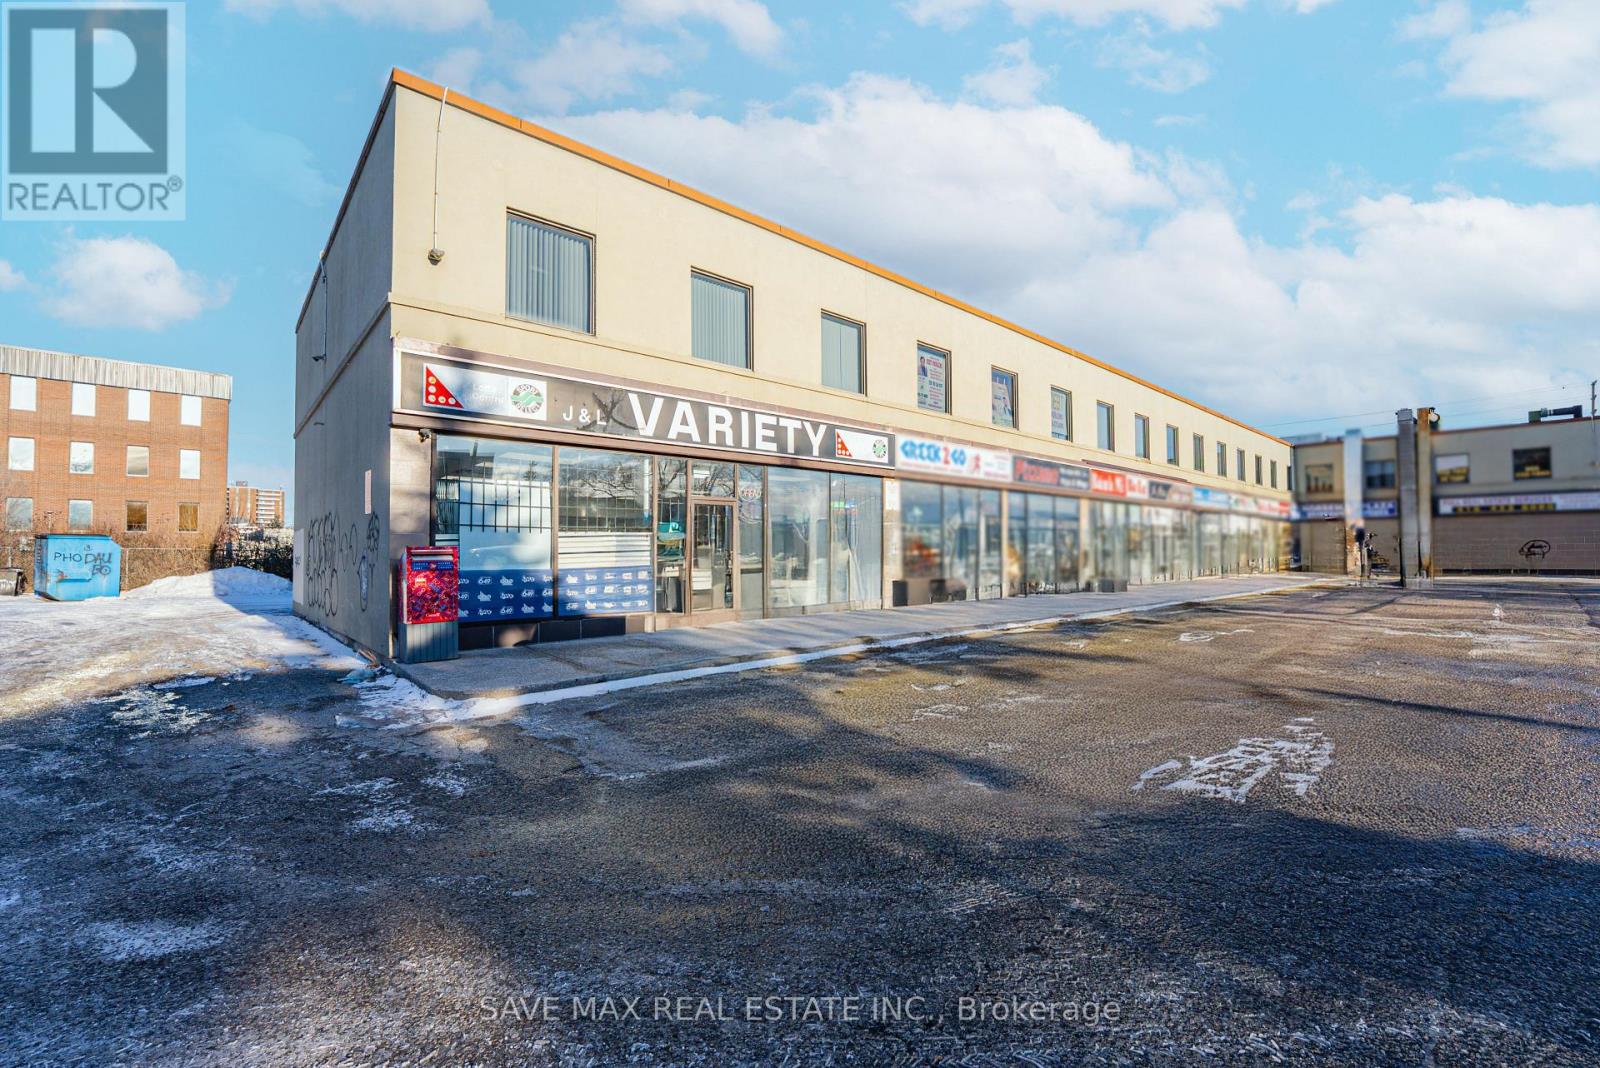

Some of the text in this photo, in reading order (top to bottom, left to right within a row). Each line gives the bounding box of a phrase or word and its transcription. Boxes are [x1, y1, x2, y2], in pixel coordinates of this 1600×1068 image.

[562, 393, 827, 457] J & L VARIETY
[54, 552, 82, 562] PHO
